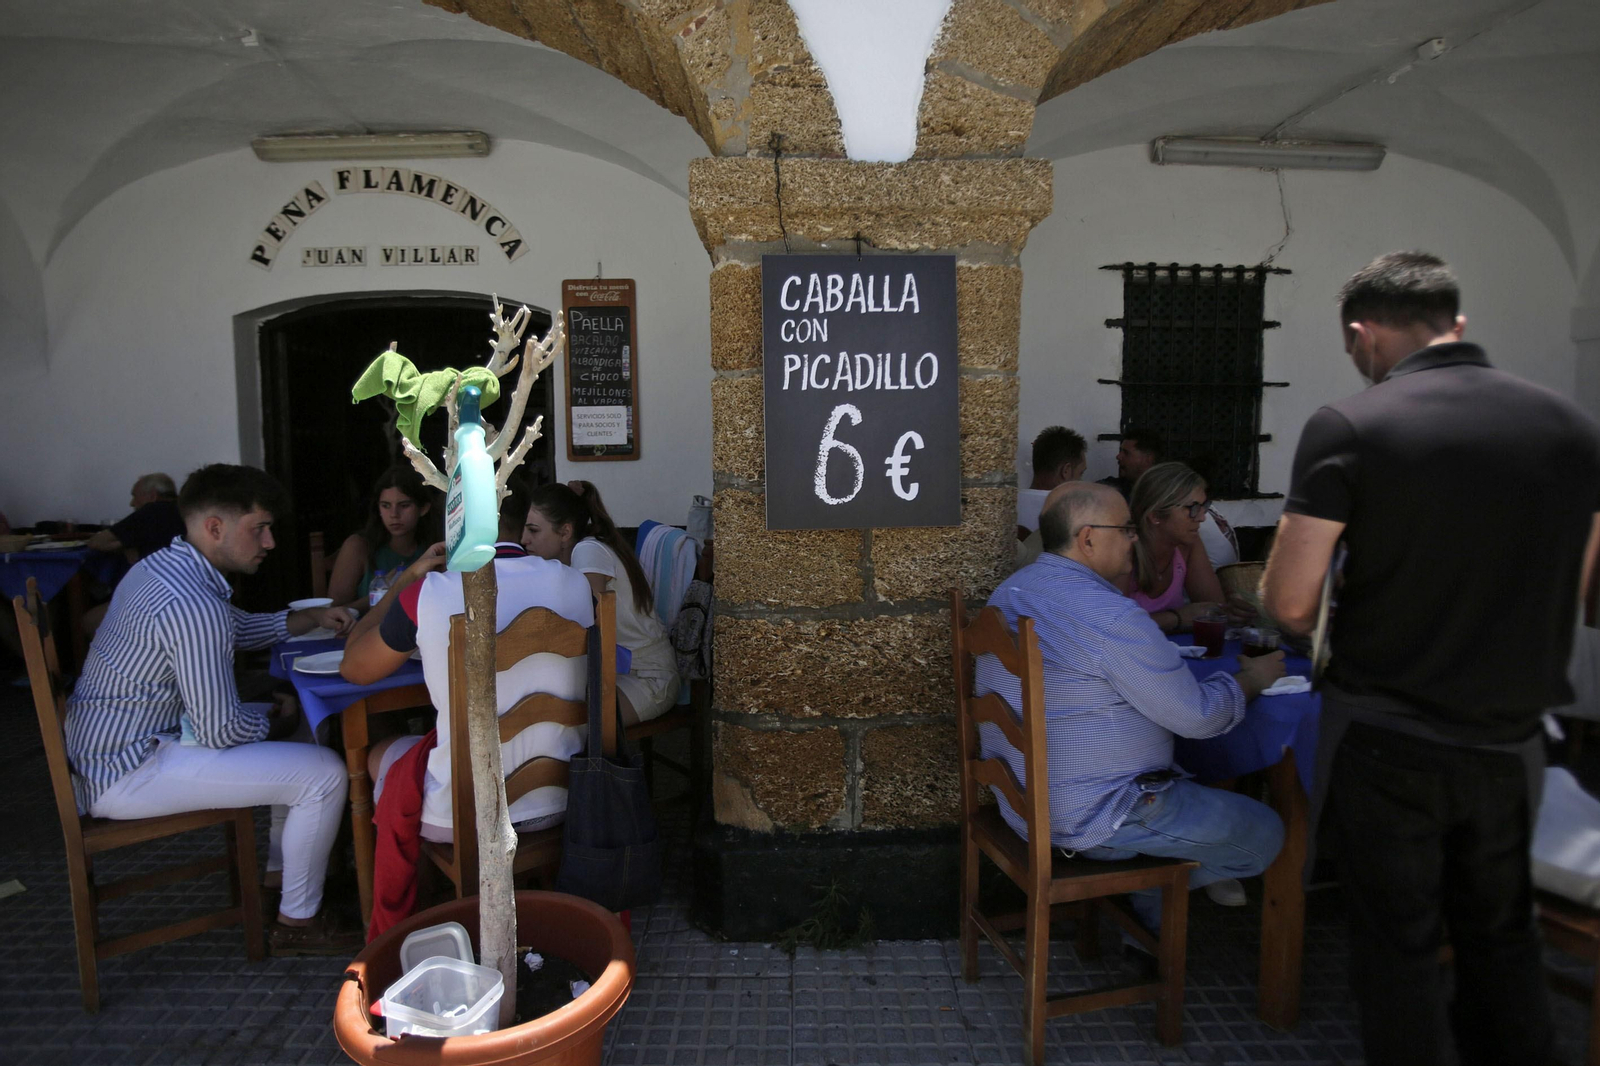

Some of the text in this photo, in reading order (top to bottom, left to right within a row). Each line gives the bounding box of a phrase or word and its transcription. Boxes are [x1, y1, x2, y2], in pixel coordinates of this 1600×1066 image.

[250, 169, 523, 268] PEÑA FLAMENCA
[302, 247, 476, 265] JUAN VILLAR
[780, 273, 920, 313] CABALLA
[570, 310, 624, 332] PAELLA
[780, 318, 829, 343] CON
[580, 373, 620, 382] CHOCO
[782, 351, 939, 392] PICADILLO
[572, 386, 632, 398] MEJILLONES
[593, 398, 624, 406] VAPOR
[814, 403, 925, 506] 6 €
